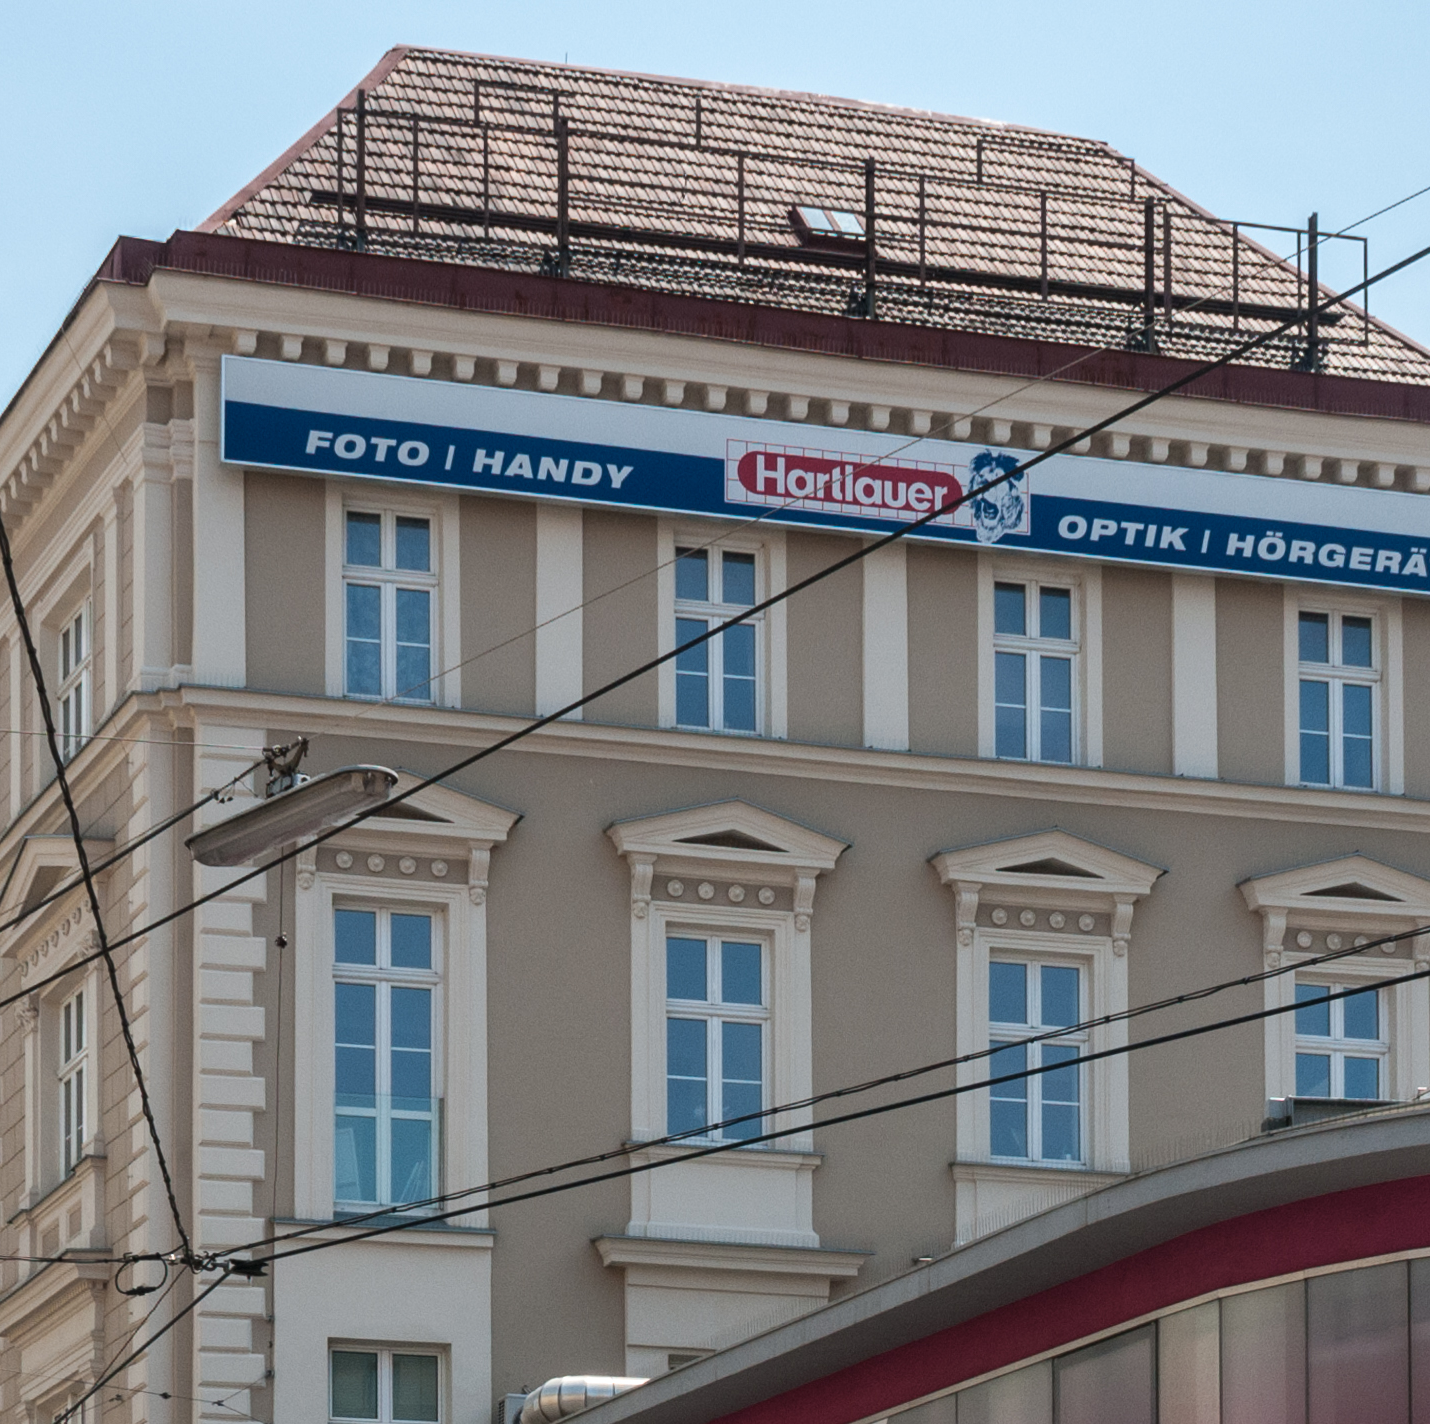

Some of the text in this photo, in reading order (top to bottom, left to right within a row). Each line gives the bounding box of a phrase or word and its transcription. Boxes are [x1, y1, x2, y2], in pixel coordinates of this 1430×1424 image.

[305, 428, 638, 490] FOTO HANDY
[753, 451, 952, 513] Hartlauer
[1057, 513, 1188, 551] OPTIK
